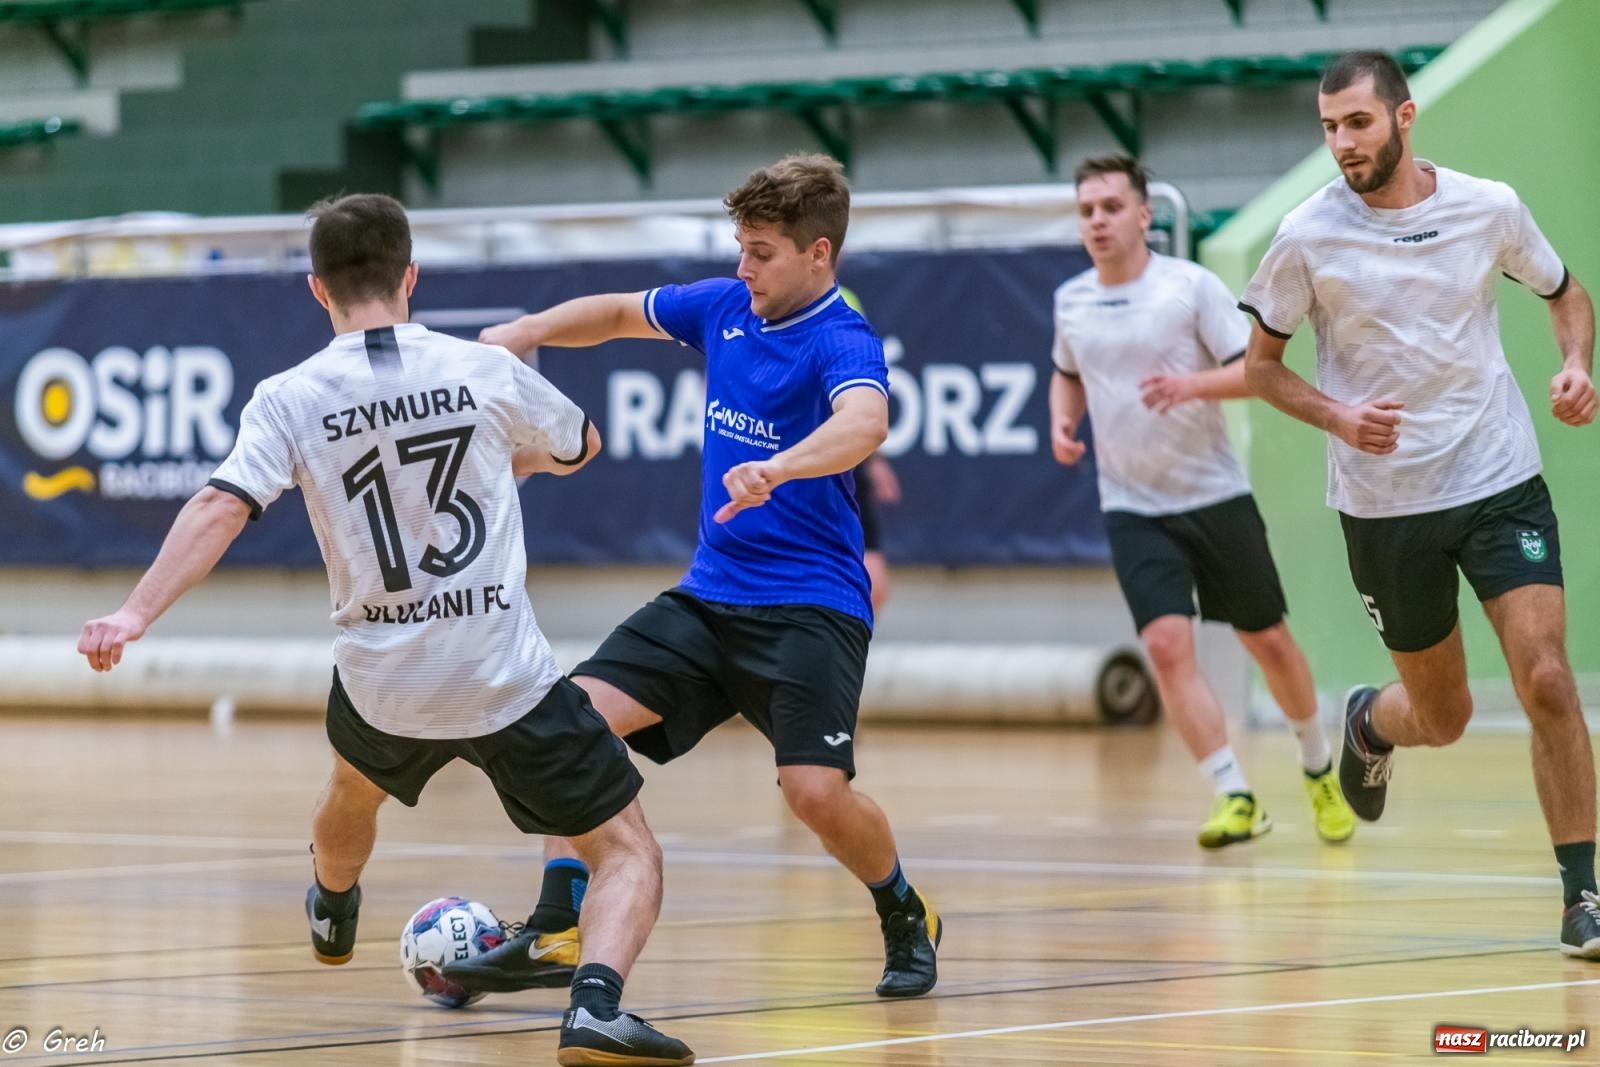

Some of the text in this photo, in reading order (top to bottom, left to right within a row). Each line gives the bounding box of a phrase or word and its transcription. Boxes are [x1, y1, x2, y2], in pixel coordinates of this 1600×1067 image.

[322, 385, 478, 442] SZYMURA
[734, 433, 780, 451] INSTALACYJNE
[341, 424, 487, 593] 13
[483, 583, 511, 614] FC
[450, 916, 469, 961] ELECT
